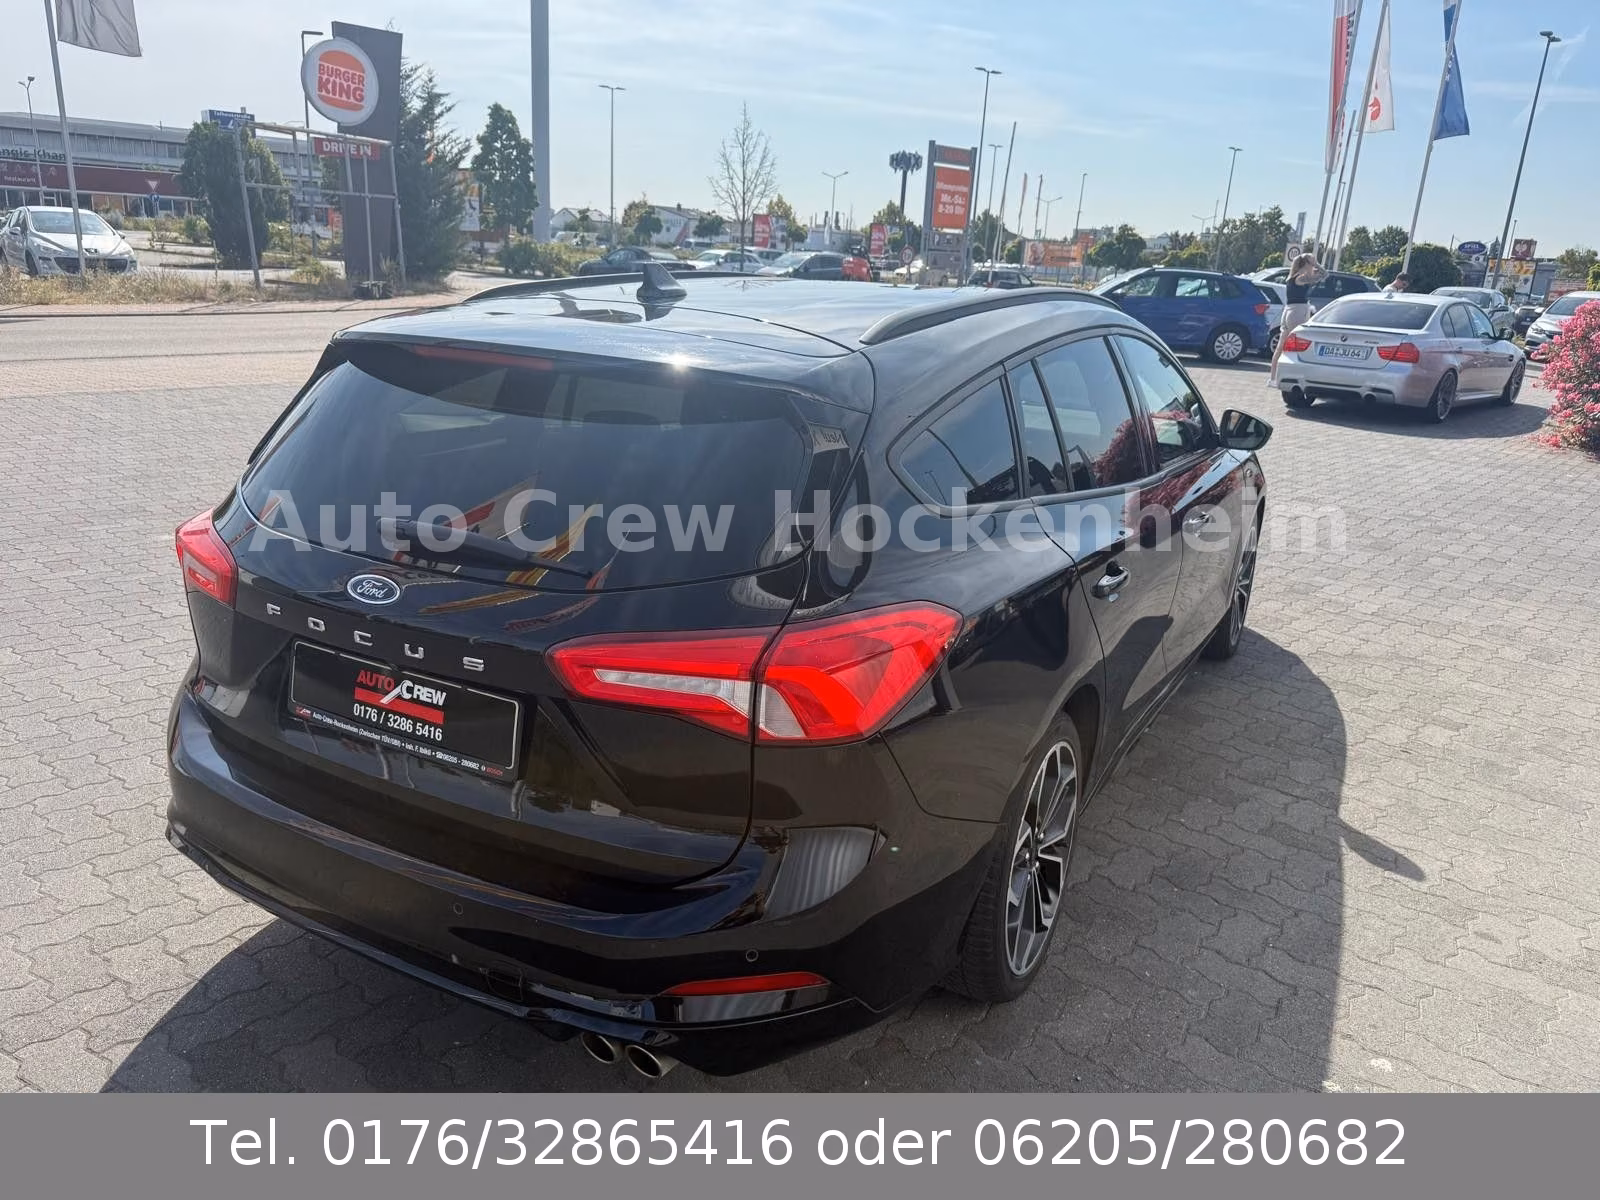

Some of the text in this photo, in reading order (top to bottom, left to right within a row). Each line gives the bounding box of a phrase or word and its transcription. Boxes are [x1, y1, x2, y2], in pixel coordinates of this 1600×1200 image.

[318, 63, 365, 87] BURGER
[317, 75, 365, 103] KING
[322, 141, 372, 156] DRIVE IN
[1324, 346, 1335, 355] DA
[356, 579, 389, 598] Ford
[266, 603, 485, 672] FOCUS
[356, 669, 446, 706] AUTO CREW
[353, 703, 443, 741] 0176 / 3286 5416
